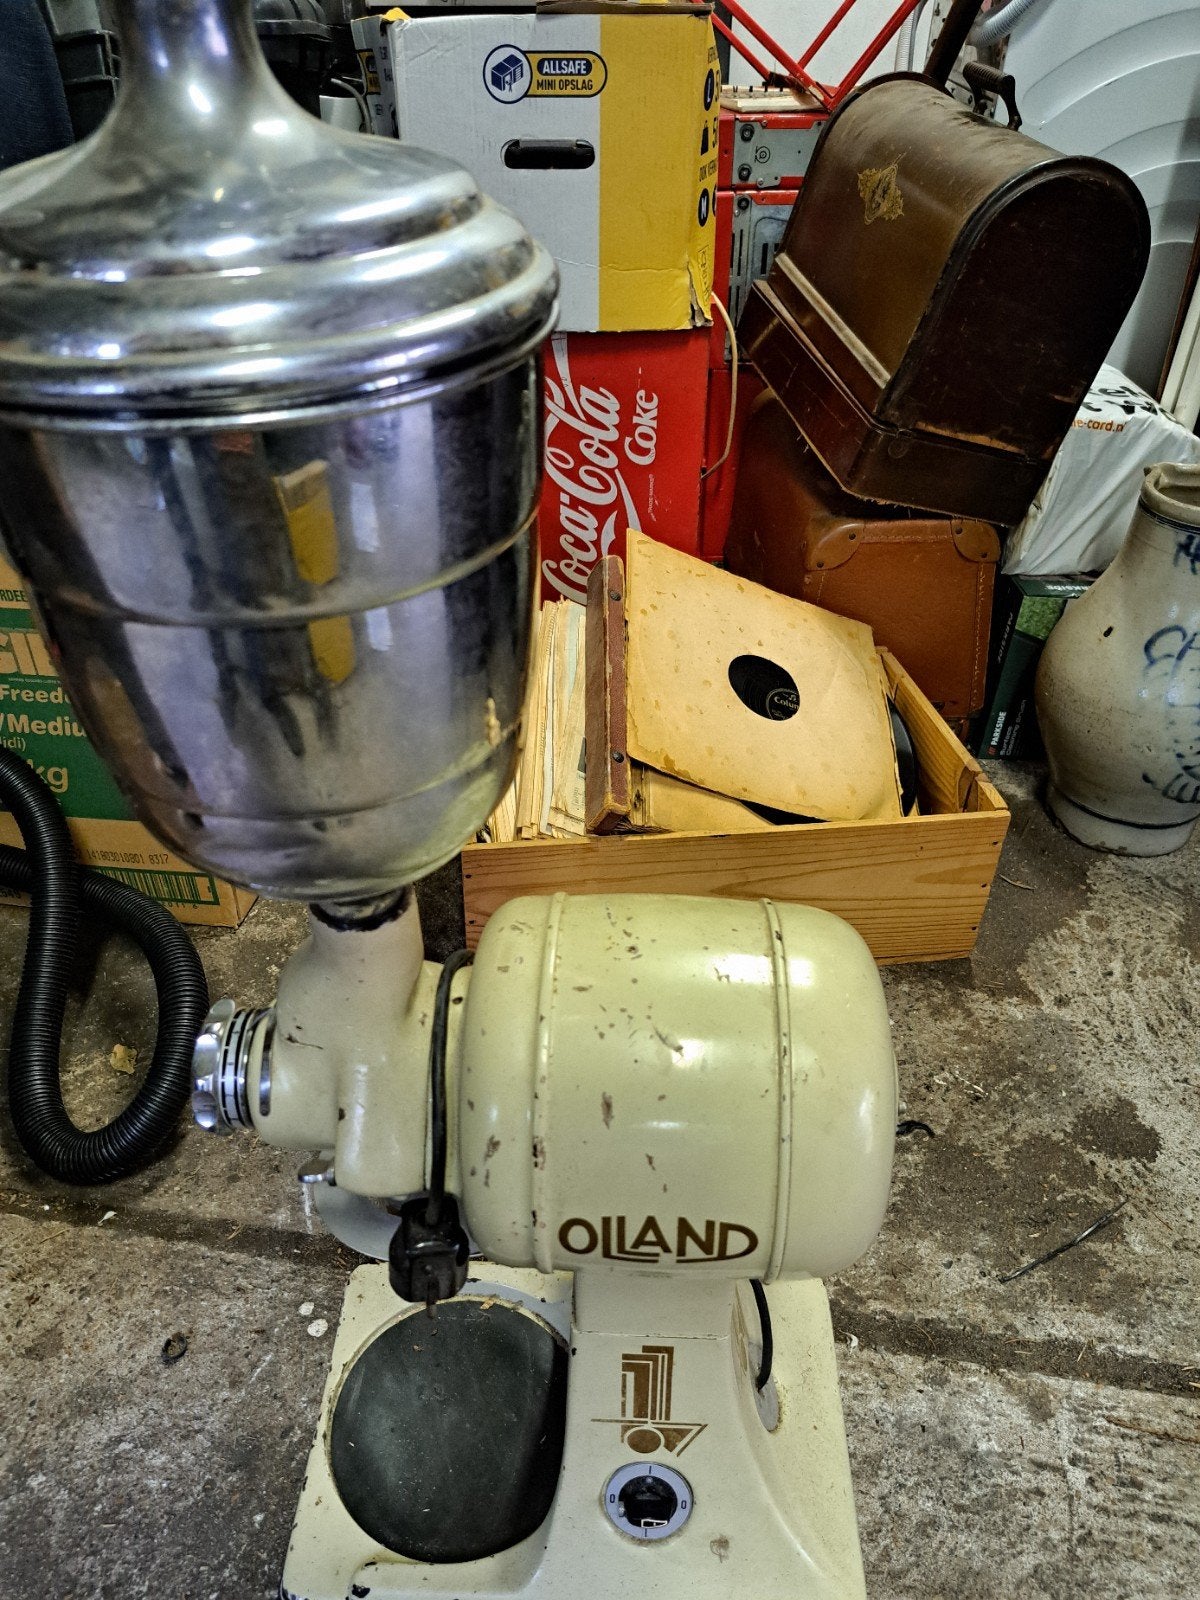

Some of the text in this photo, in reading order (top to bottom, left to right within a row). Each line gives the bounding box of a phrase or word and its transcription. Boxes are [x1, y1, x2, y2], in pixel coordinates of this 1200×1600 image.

[542, 60, 587, 74] ALLSAFE
[537, 79, 593, 91] MINI OPSLAG
[624, 389, 659, 466] Coke
[541, 376, 621, 606] Coca-Cola
[990, 711, 1007, 746] PARKSIDE
[0, 736, 26, 752] idi)
[148, 853, 169, 865] 8317
[558, 1215, 759, 1264] OLLAND
